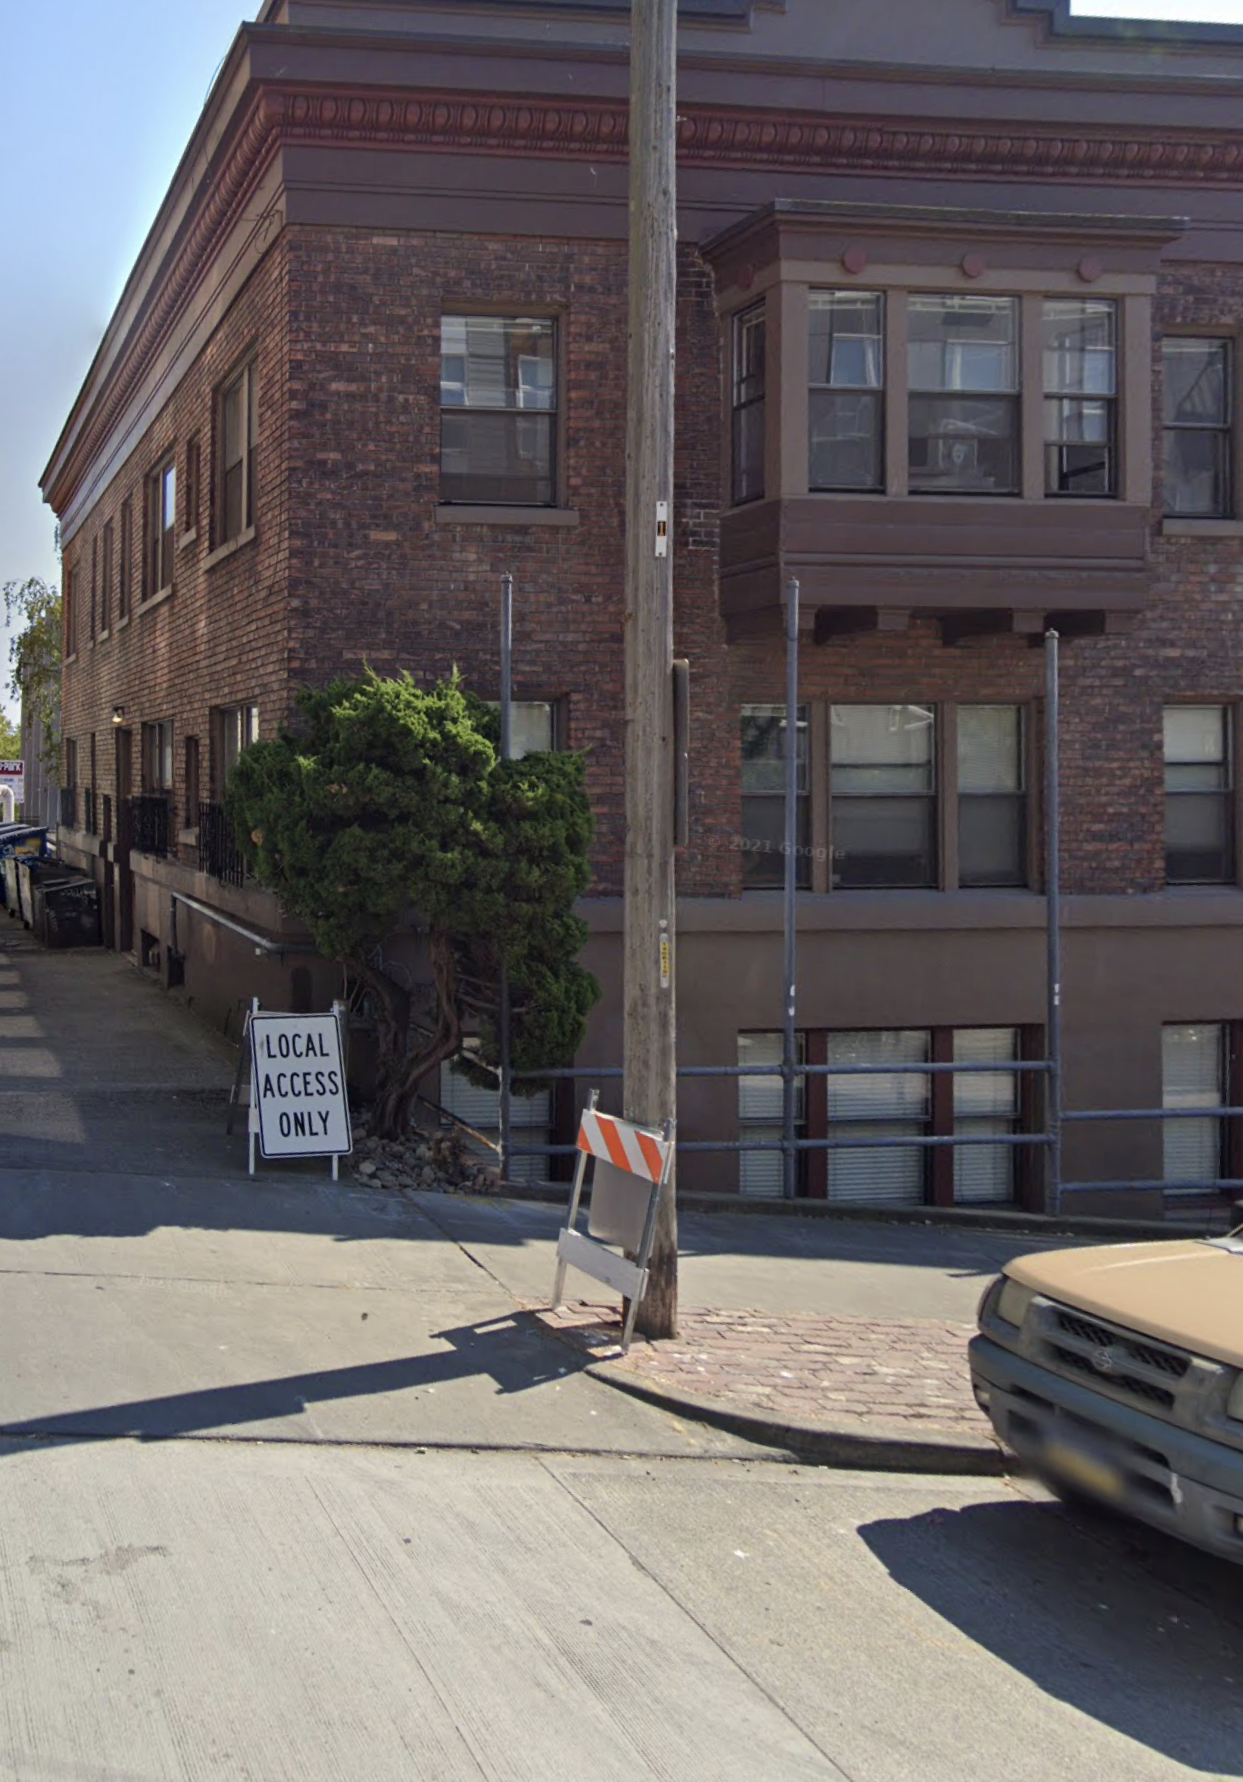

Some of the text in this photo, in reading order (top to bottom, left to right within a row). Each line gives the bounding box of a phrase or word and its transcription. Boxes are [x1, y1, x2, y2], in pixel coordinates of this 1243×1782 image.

[265, 1032, 330, 1059] LOCAL
[263, 1070, 340, 1099] ACCESS
[279, 1110, 330, 1138] ONLY
